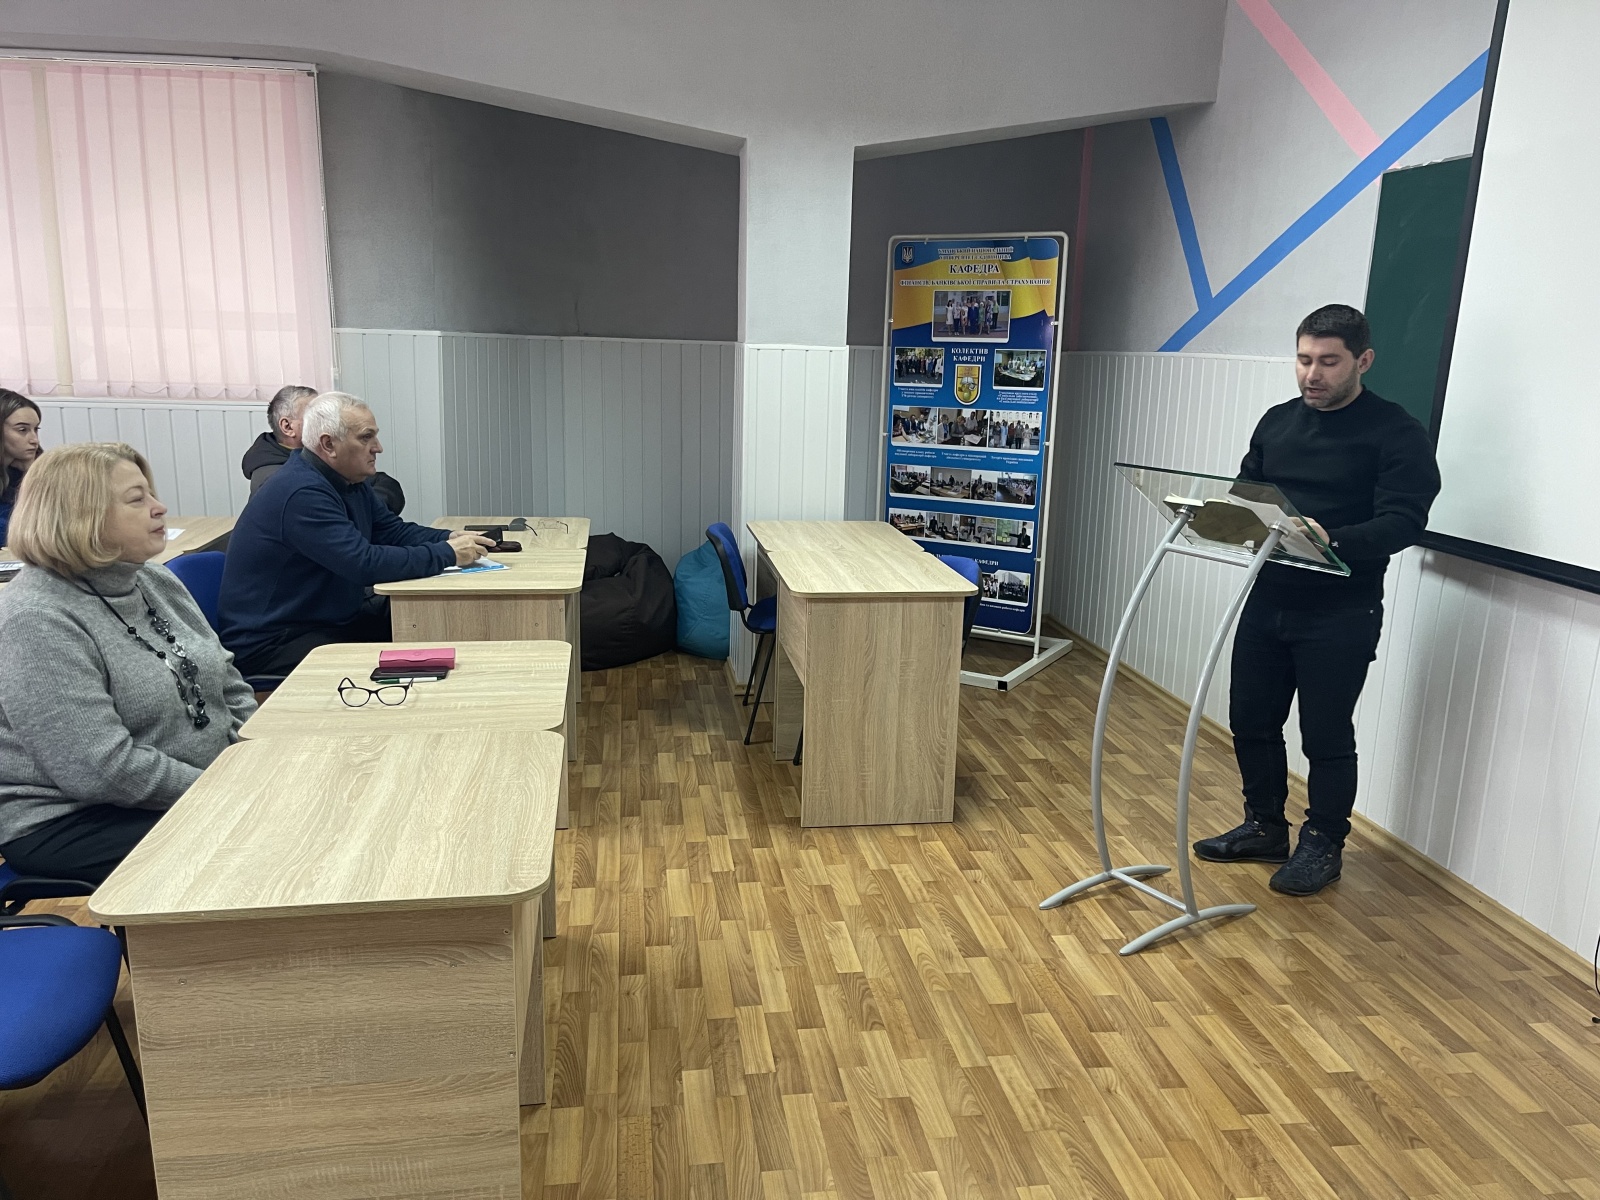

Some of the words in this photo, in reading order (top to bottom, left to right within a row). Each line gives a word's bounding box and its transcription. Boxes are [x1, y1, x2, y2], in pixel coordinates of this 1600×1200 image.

[949, 263, 1000, 275] КАФЕДРА
[951, 347, 989, 355] КОЛЕКТИВ
[953, 355, 986, 363] КАФЕДРИ
